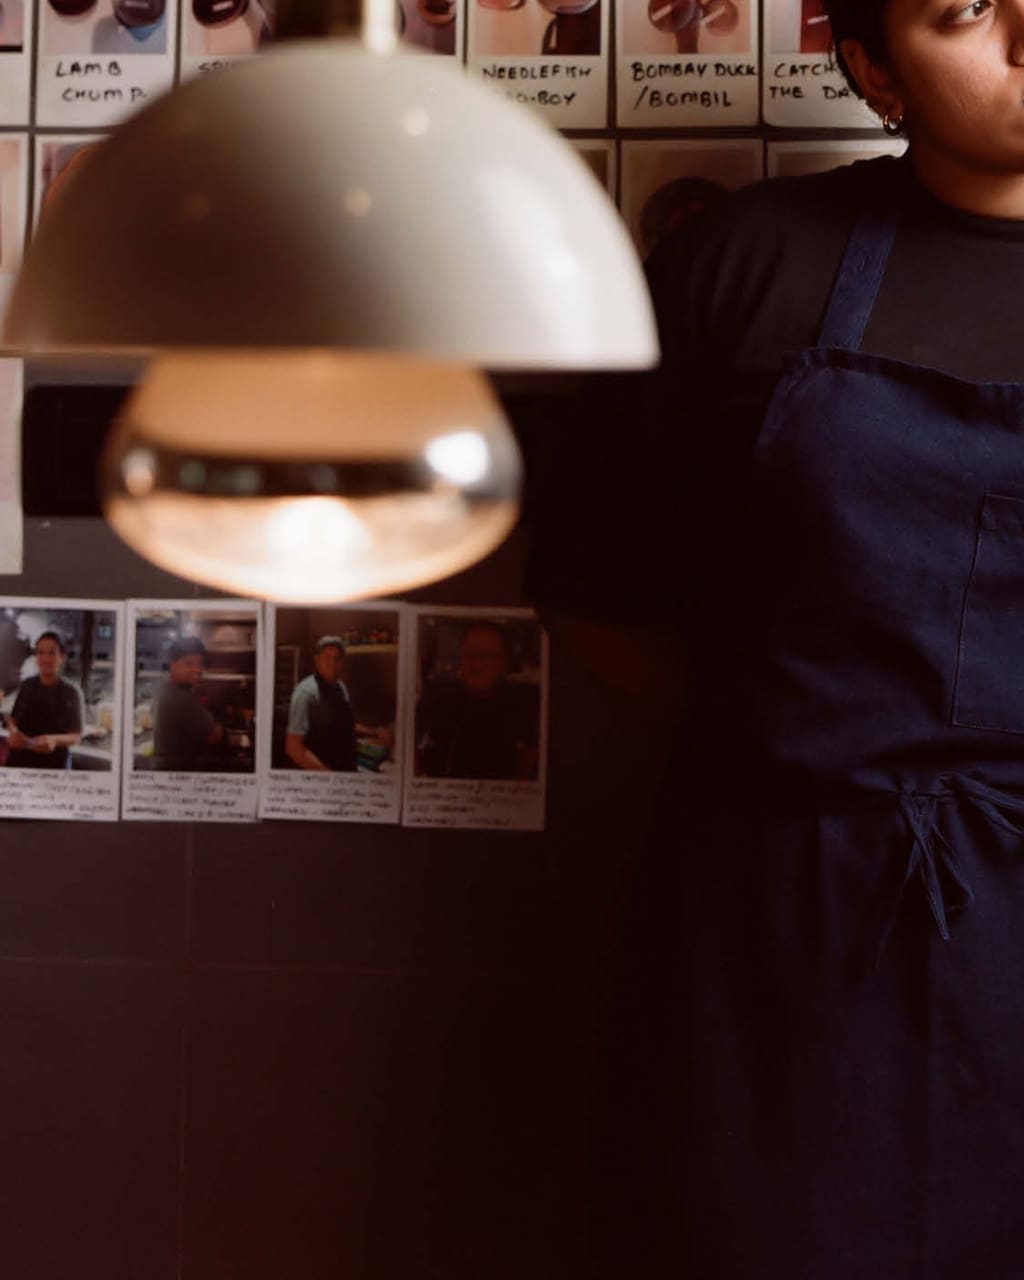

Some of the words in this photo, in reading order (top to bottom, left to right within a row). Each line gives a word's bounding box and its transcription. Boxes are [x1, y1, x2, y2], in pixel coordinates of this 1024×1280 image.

[55, 61, 122, 77] LAMB
[631, 61, 708, 81] BOMBAY
[714, 62, 758, 77] DUCK
[769, 86, 804, 98] THE
[823, 86, 850, 99] DA
